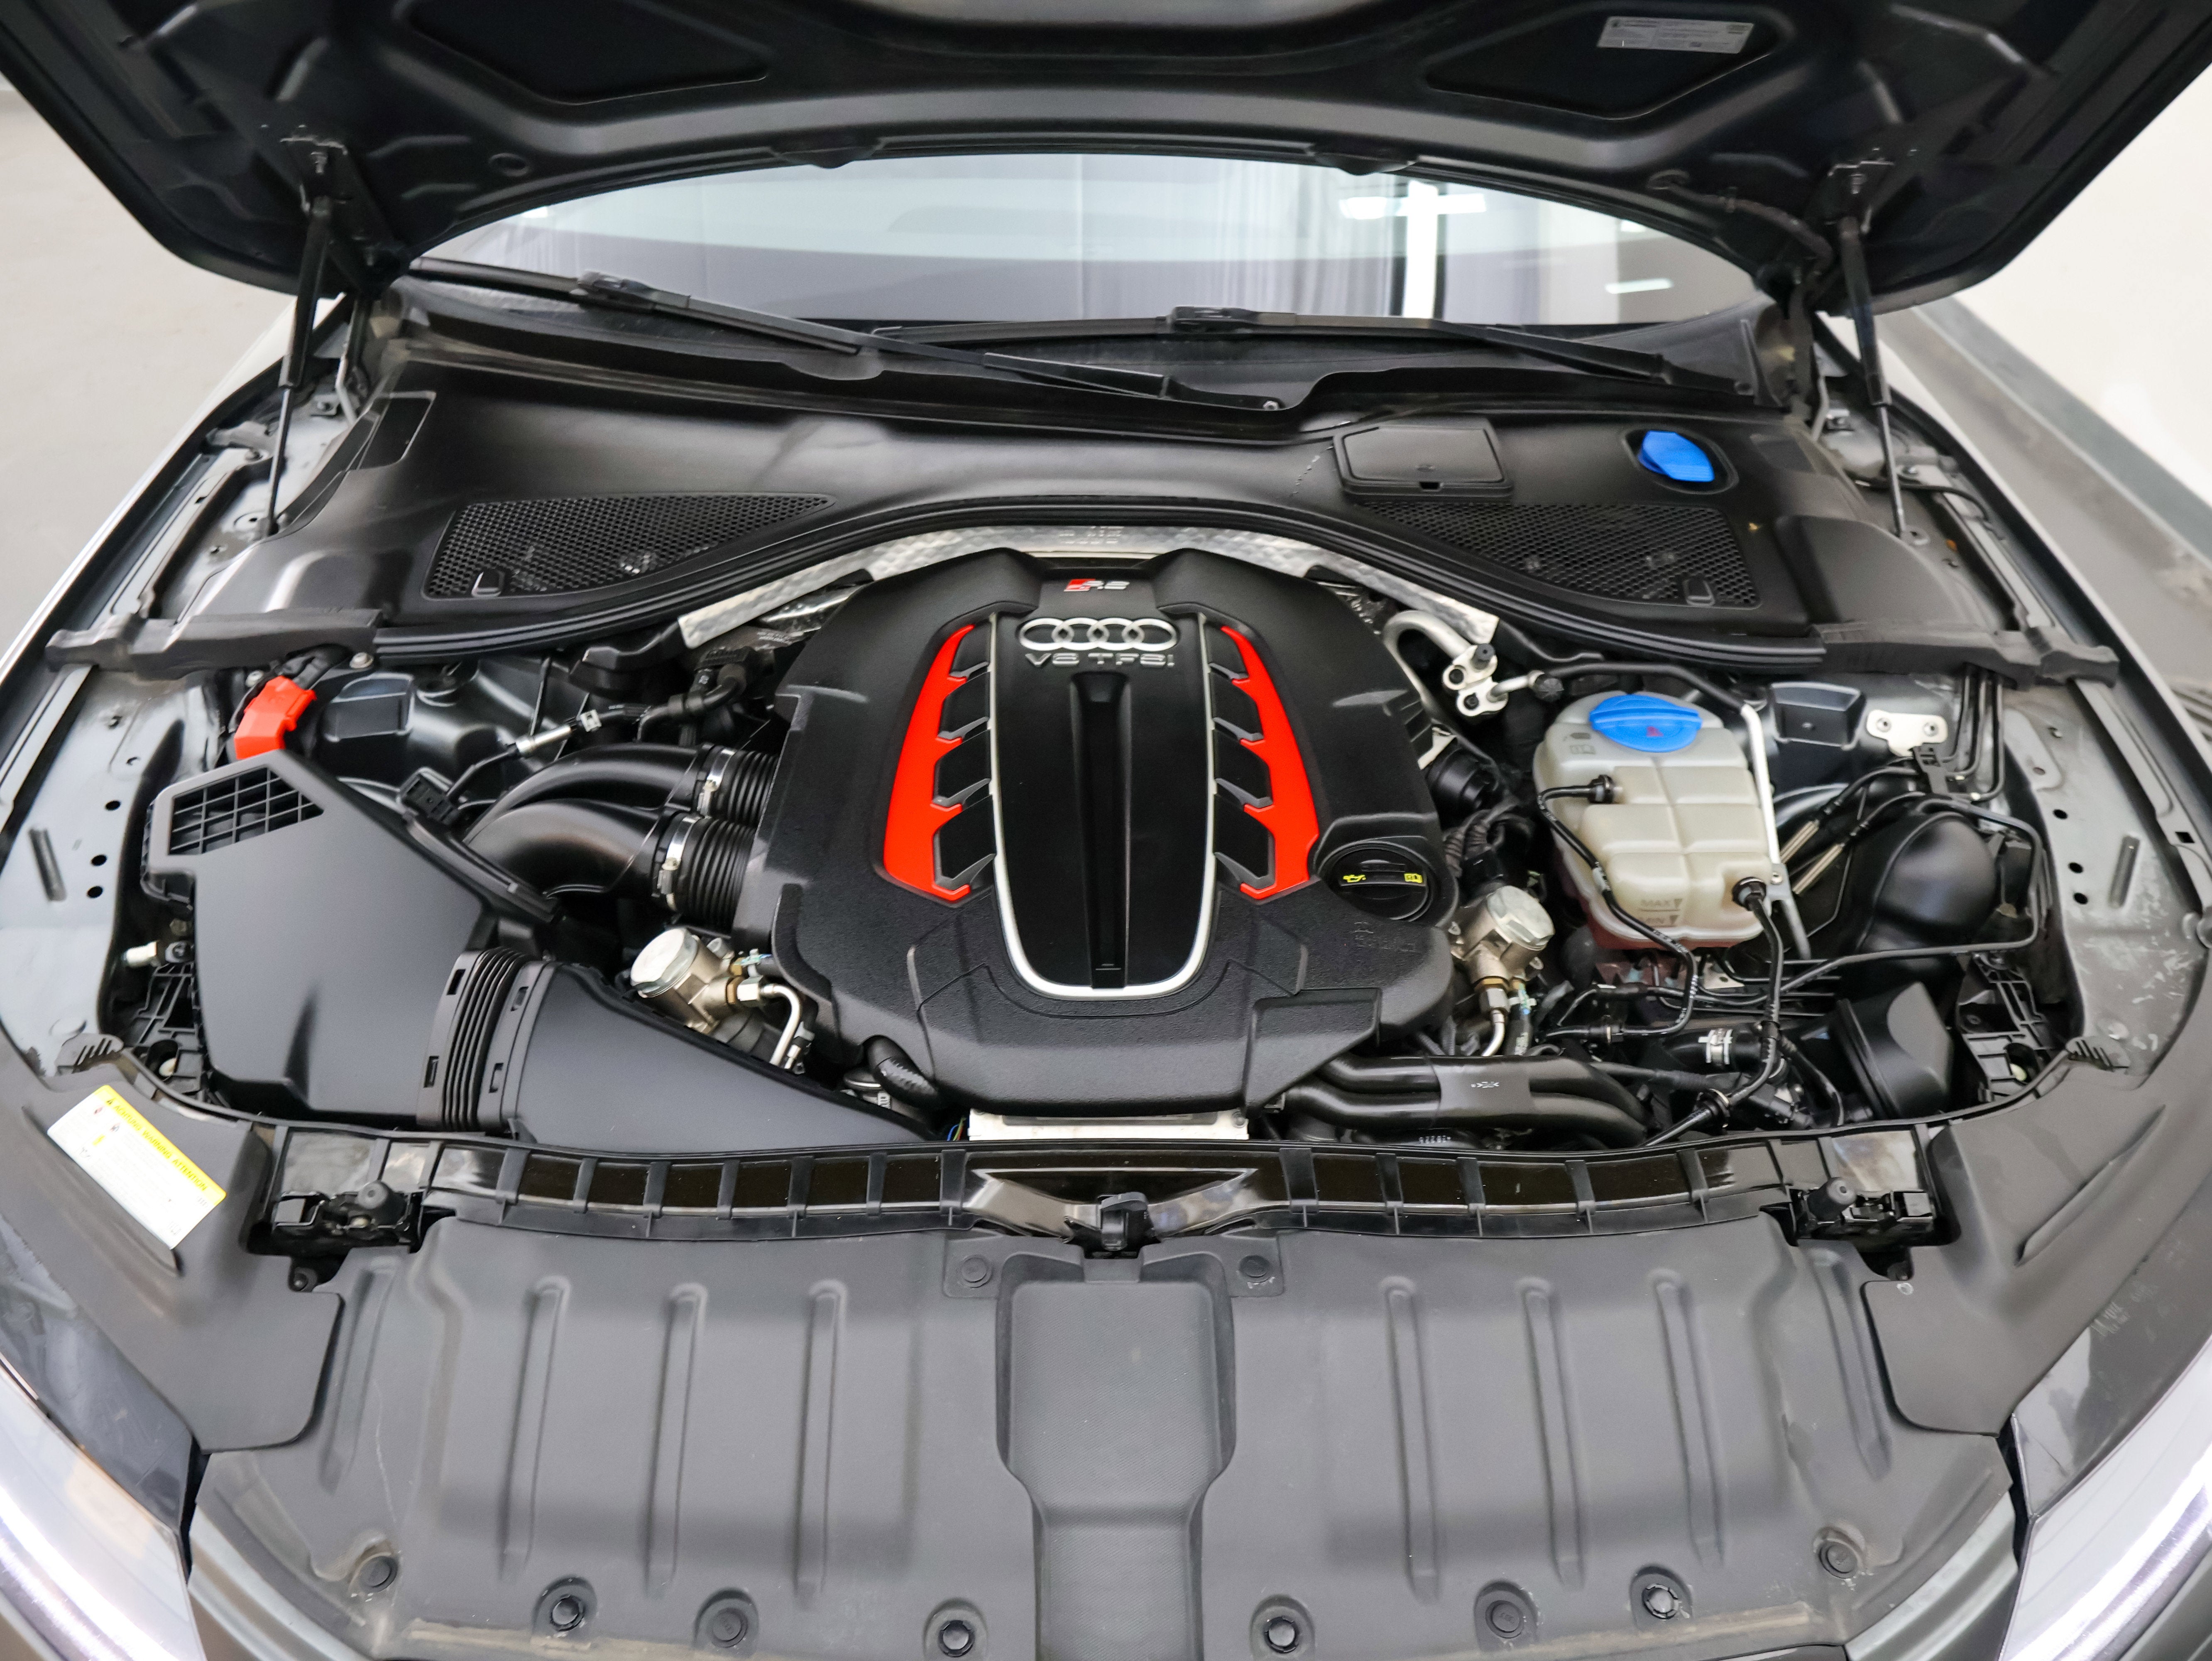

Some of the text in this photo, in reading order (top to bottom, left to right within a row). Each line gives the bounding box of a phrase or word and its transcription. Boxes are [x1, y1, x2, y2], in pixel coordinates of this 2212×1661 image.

[1024, 653, 1080, 667] V8
[114, 1105, 142, 1130] ACHTUNG
[142, 1130, 172, 1159] WARNING
[172, 1159, 208, 1191] ATTENTION
